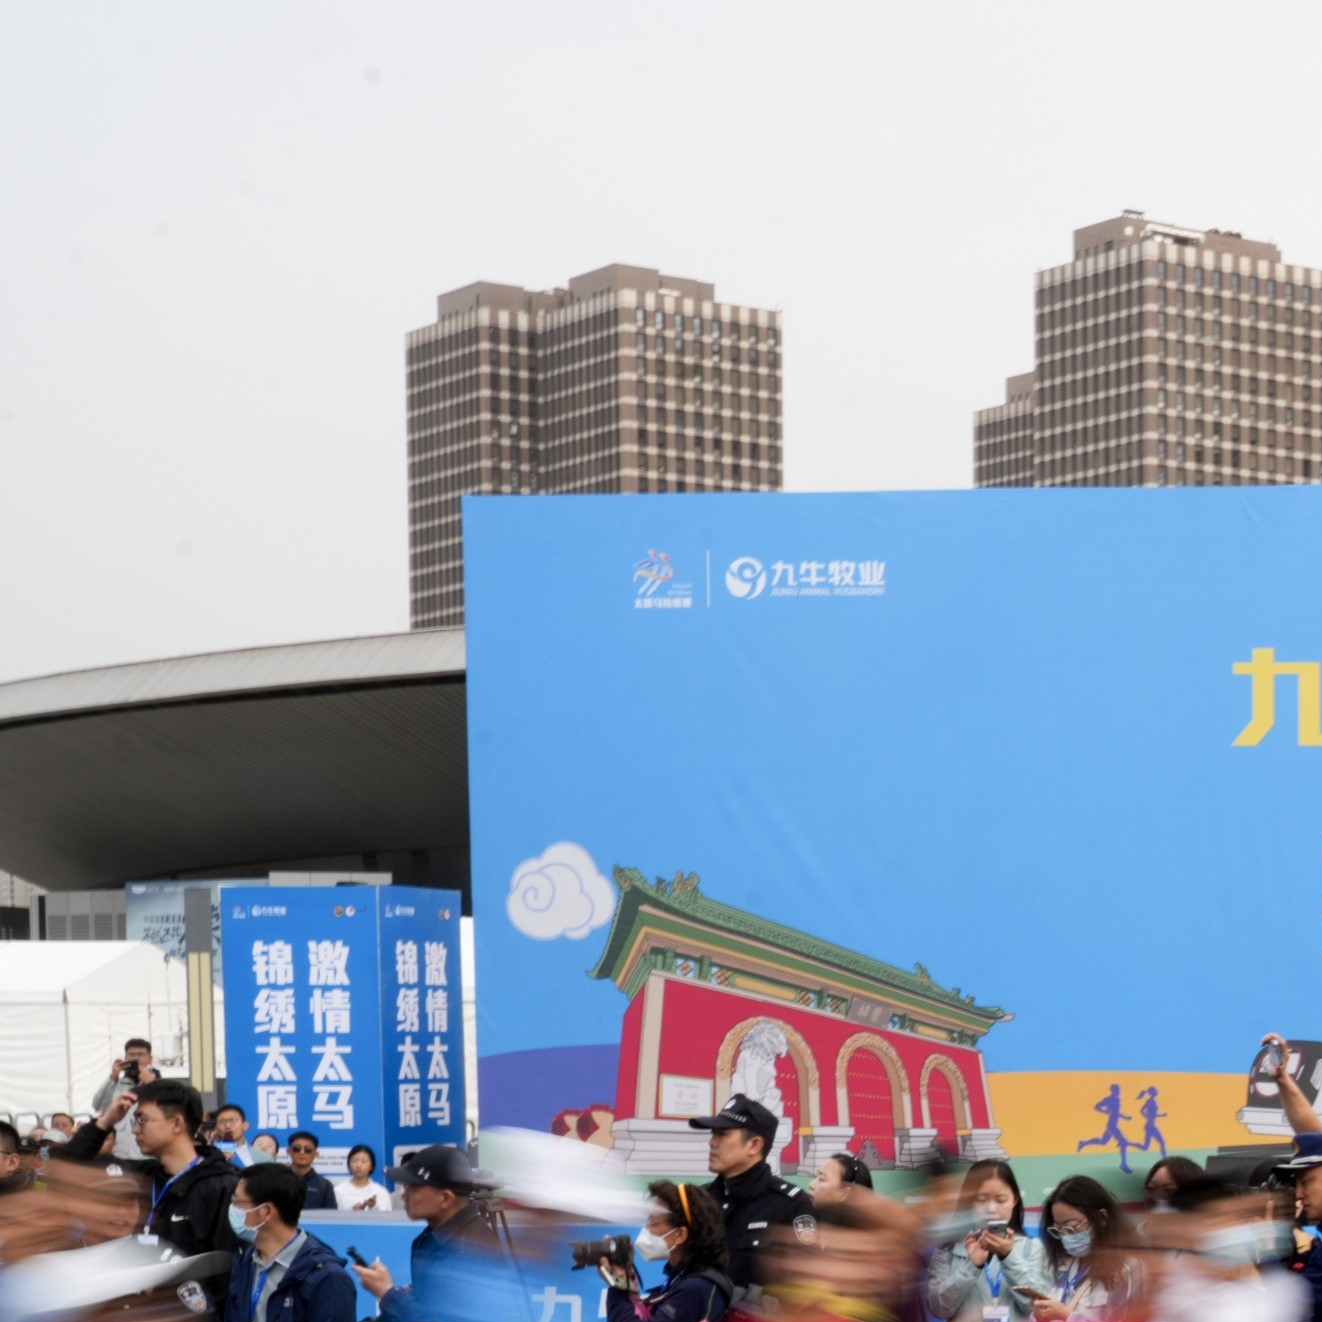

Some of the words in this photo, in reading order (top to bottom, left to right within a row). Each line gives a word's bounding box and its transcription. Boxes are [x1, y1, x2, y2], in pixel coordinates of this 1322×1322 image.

[771, 560, 886, 587] 九牛牧业
[251, 940, 299, 1130] 锦绣太原
[307, 940, 355, 1130] 激情太马
[395, 940, 421, 1127] 锦绣太原
[424, 941, 451, 1126] 激情太马
